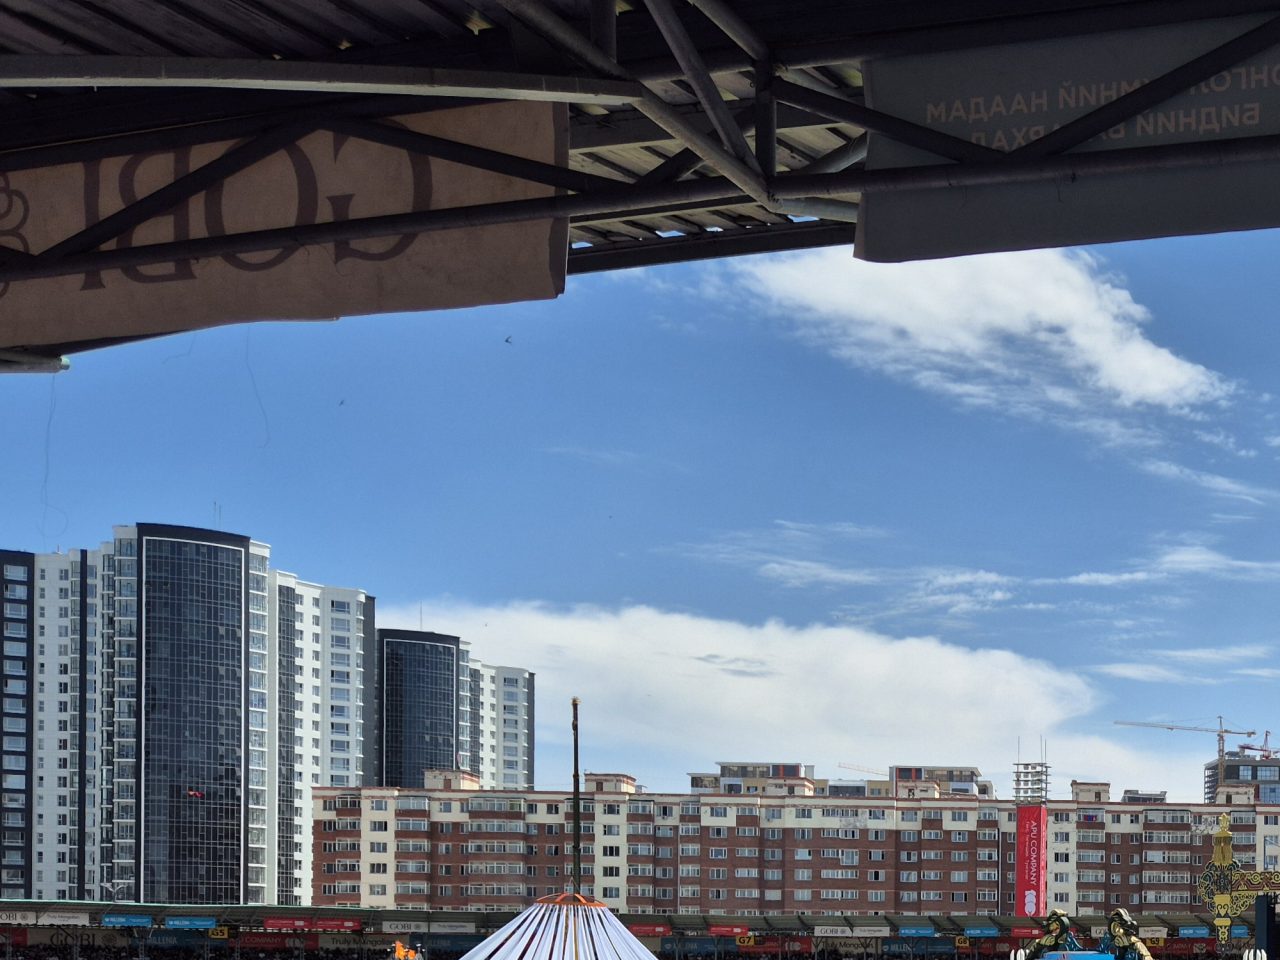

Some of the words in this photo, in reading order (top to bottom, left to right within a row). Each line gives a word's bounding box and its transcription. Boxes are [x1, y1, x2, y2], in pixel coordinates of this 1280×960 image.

[1030, 820, 1038, 838] APU
[1029, 840, 1038, 886] COMPANY
[738, 936, 752, 945] G7
